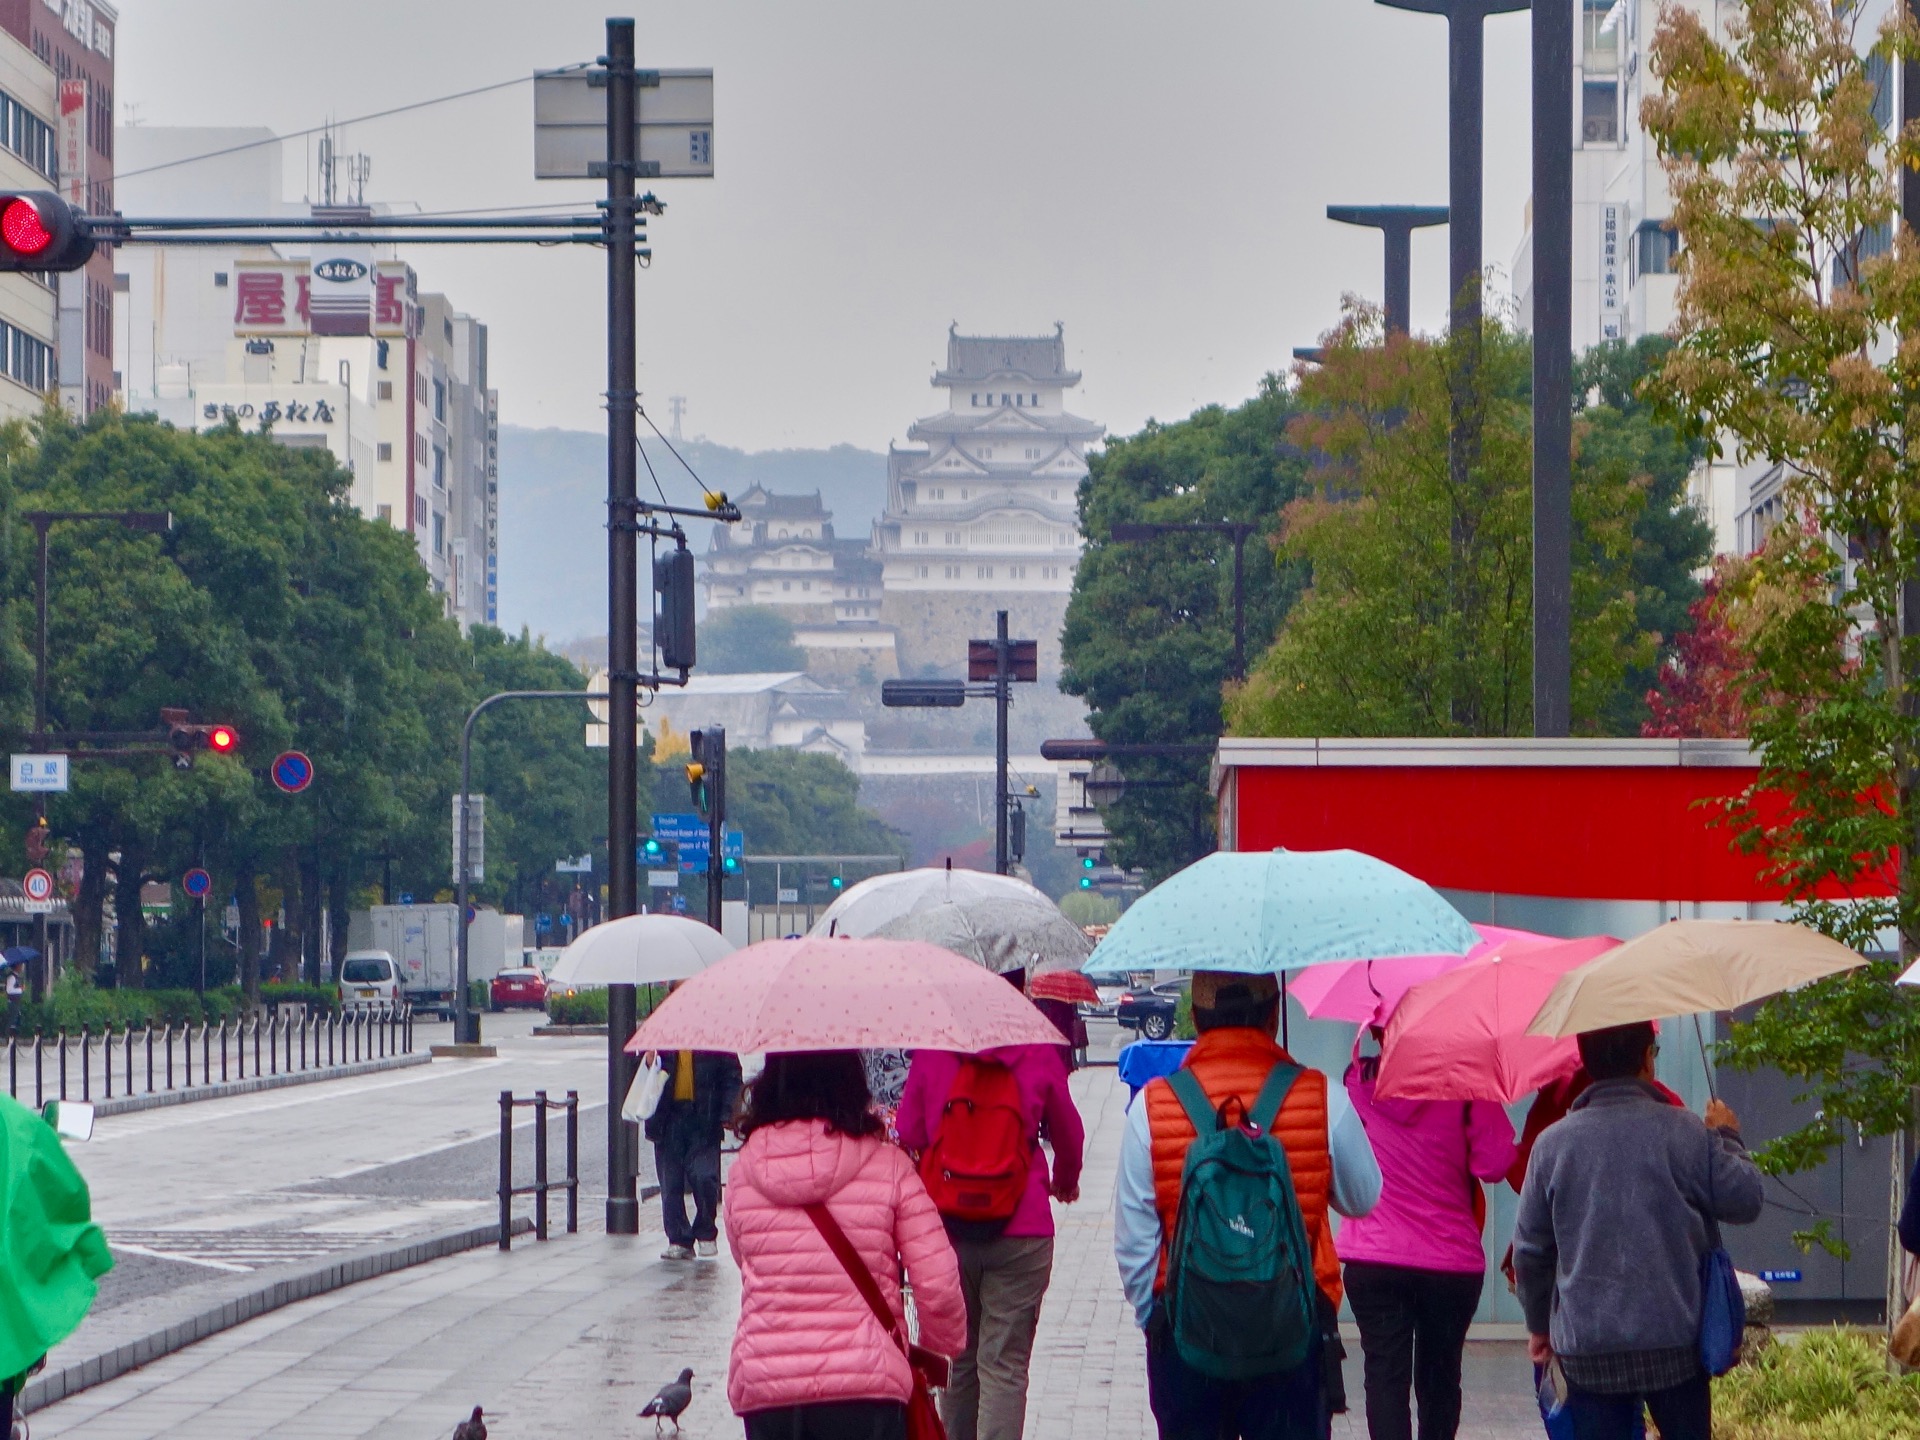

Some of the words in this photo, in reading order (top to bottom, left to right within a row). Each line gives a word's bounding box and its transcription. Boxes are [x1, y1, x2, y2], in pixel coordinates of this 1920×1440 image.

[203, 402, 254, 419] きもの
[31, 878, 46, 892] 40
